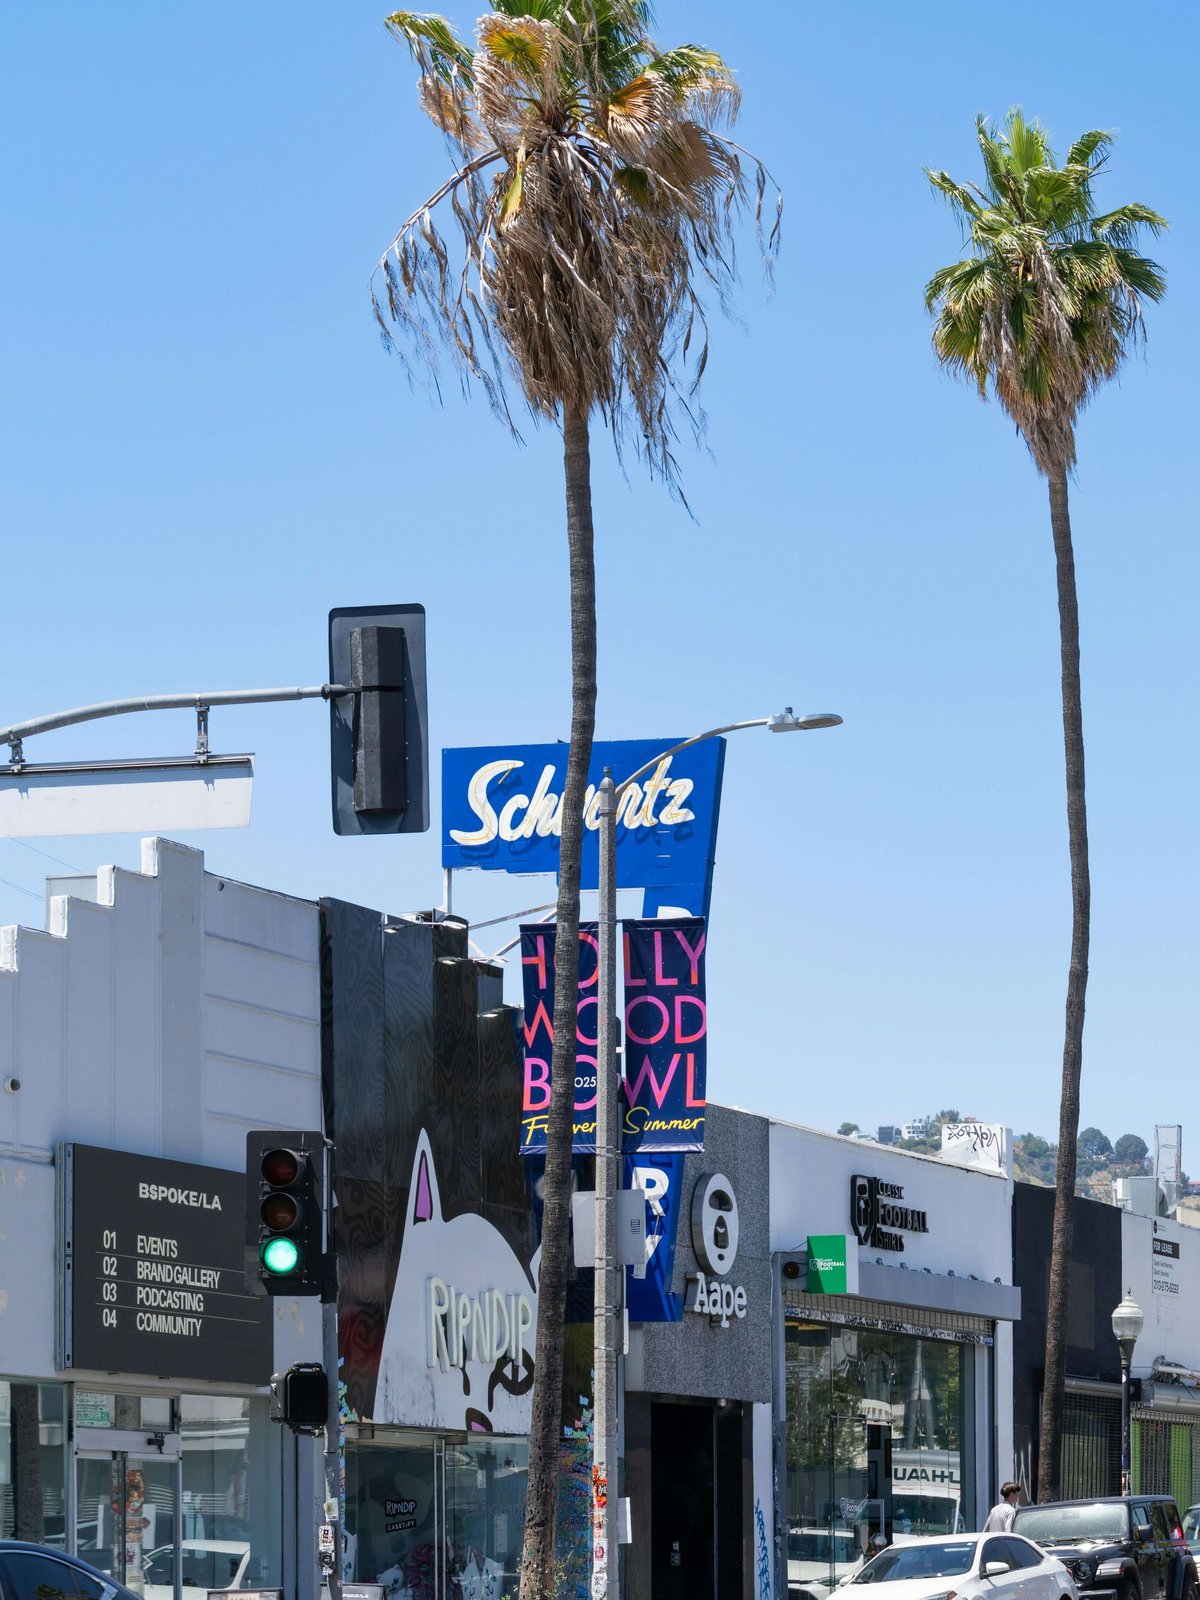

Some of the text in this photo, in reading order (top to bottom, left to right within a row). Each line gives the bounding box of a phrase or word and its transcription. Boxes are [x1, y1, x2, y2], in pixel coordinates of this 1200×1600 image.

[450, 756, 695, 845] Schrtz
[574, 1077, 597, 1088] 025
[522, 1106, 706, 1145] Fver Summer
[138, 1182, 222, 1211] BSPOKE/LA
[103, 1230, 178, 1258] 01 EVENTS
[103, 1257, 117, 1276] 02
[103, 1283, 204, 1312] 03 PODCASTING
[694, 1272, 747, 1328] Aape
[103, 1309, 202, 1337] 04 COMMUNITY
[386, 1501, 416, 1515] RIPNDIP
